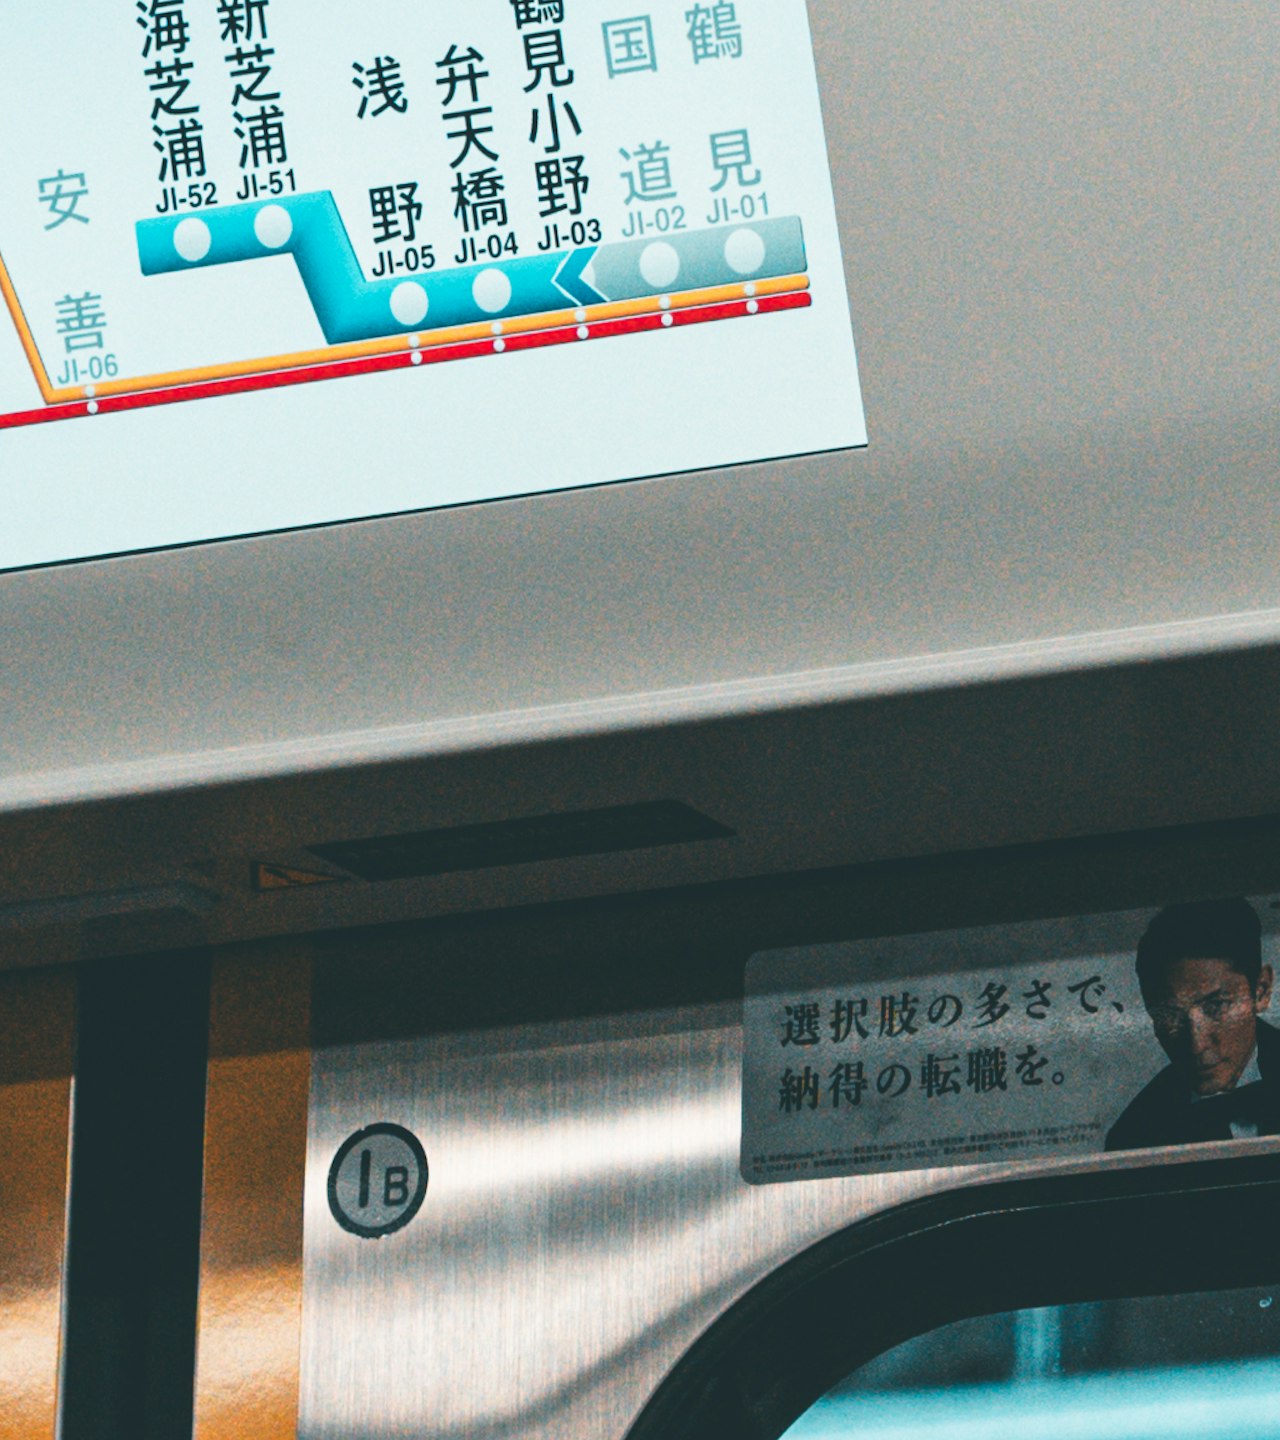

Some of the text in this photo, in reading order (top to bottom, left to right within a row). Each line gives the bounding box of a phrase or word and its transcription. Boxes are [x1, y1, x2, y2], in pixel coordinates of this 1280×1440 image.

[436, 44, 508, 233] 弁天橋
[155, 182, 218, 213] JI-52
[237, 168, 297, 200] JI-51
[621, 205, 687, 237] JI-02
[706, 192, 770, 224] JI-01
[455, 232, 519, 264] JI-04
[538, 219, 602, 251] JI-03
[372, 245, 436, 277] JI-05
[57, 354, 119, 384] JI-06
[780, 975, 1125, 1049] 選択肢の多さで、
[778, 1045, 1066, 1114] 納得の転職を。
